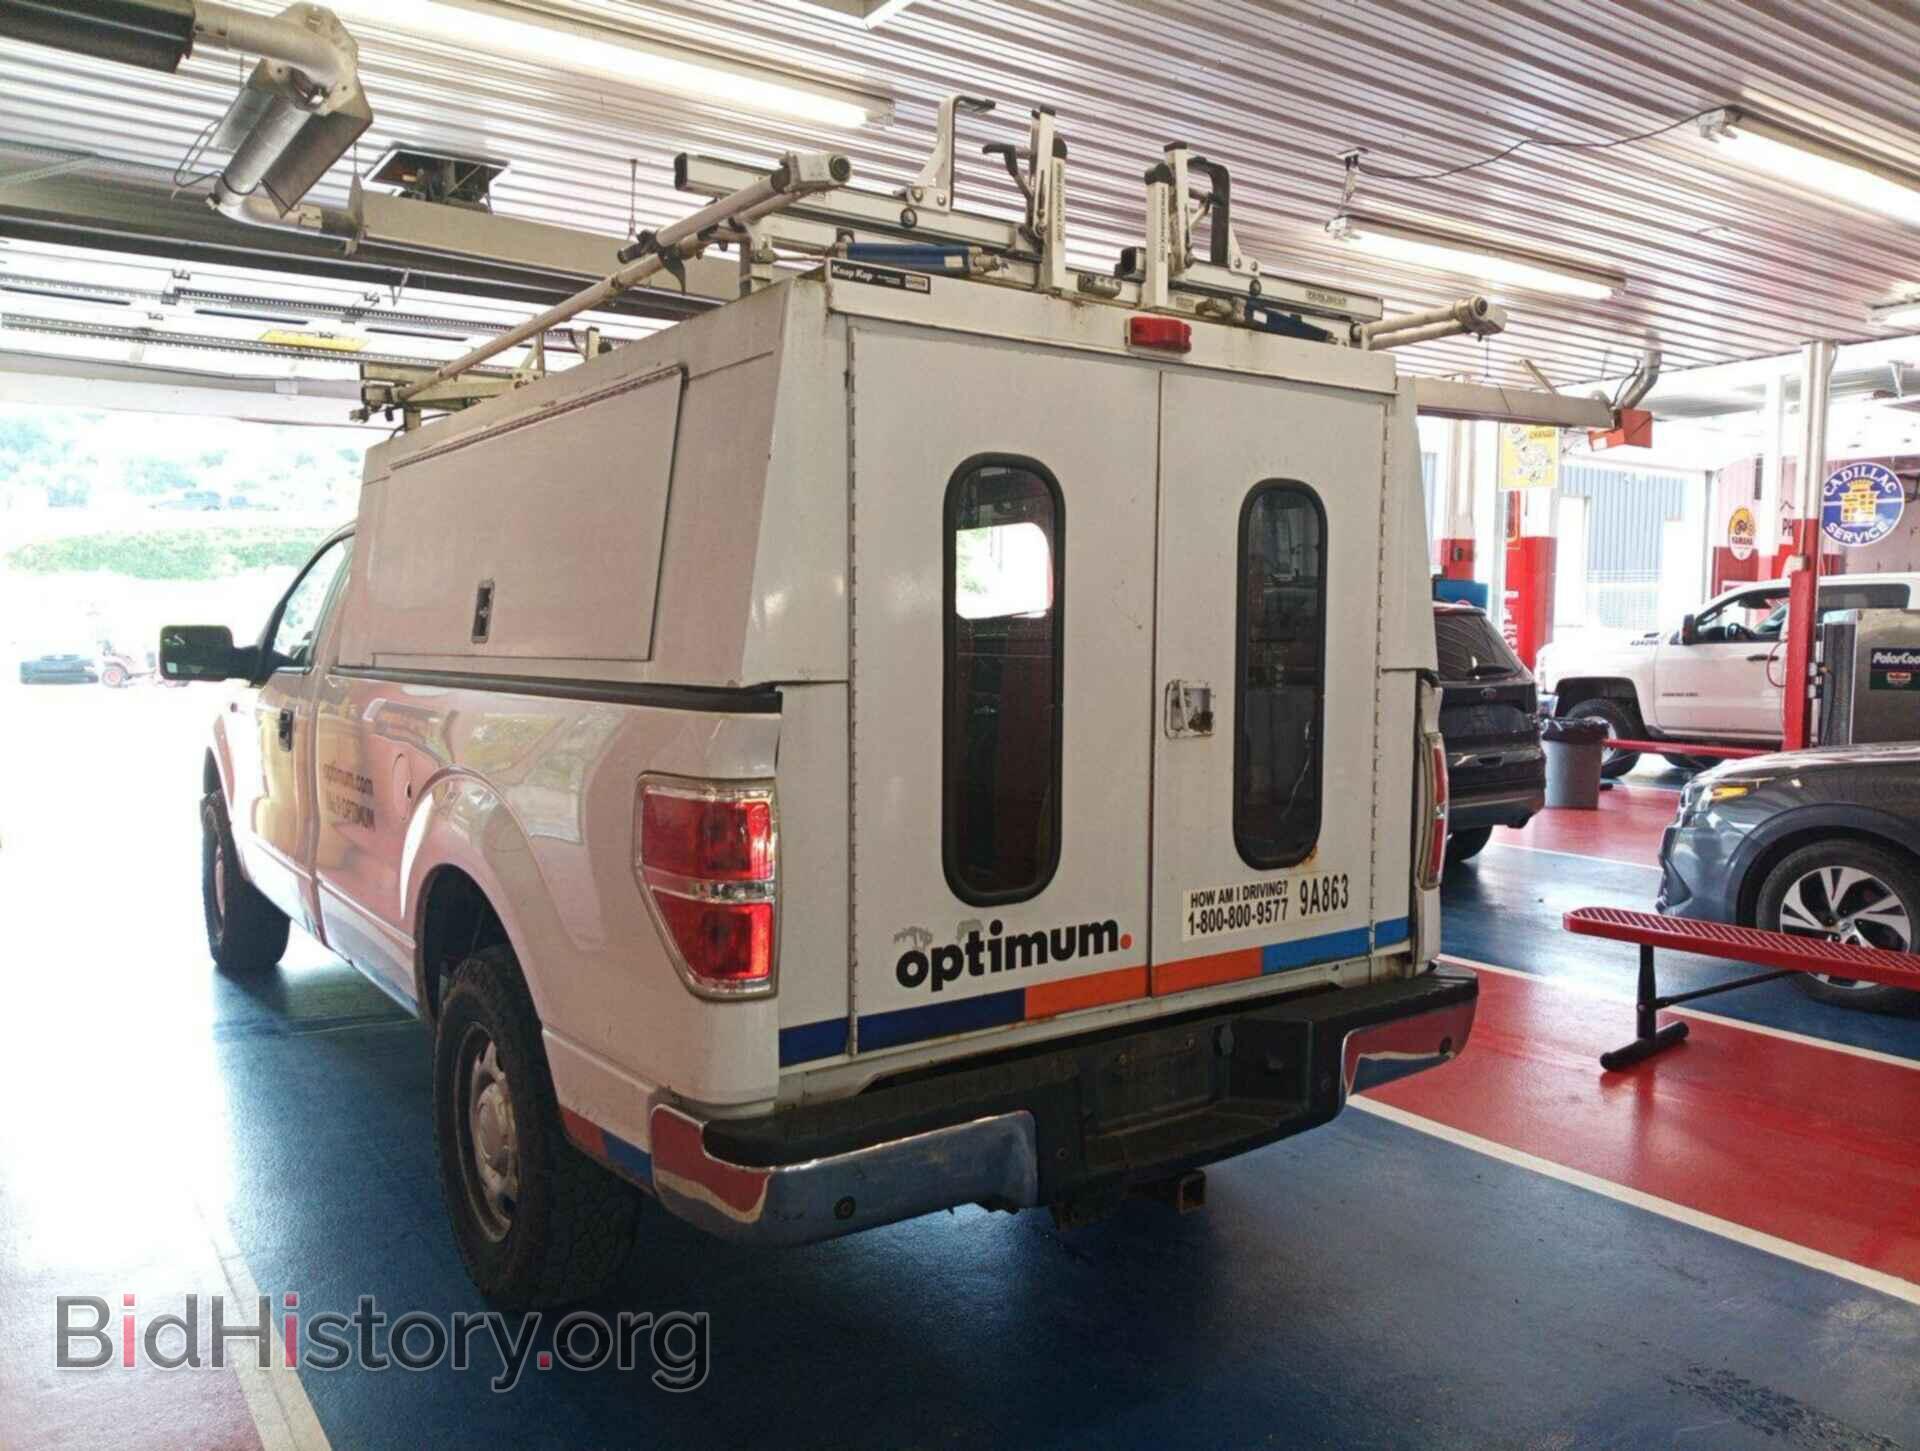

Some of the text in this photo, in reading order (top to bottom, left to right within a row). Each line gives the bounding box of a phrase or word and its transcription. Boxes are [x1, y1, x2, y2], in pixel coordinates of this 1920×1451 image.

[1823, 465, 1898, 497] CADILLAC
[1826, 521, 1890, 544] SERVICE
[1190, 879, 1289, 909] HOW AM I DRIVING?
[1300, 873, 1349, 917] 9A863
[1187, 897, 1289, 936] 1-800-800-9577
